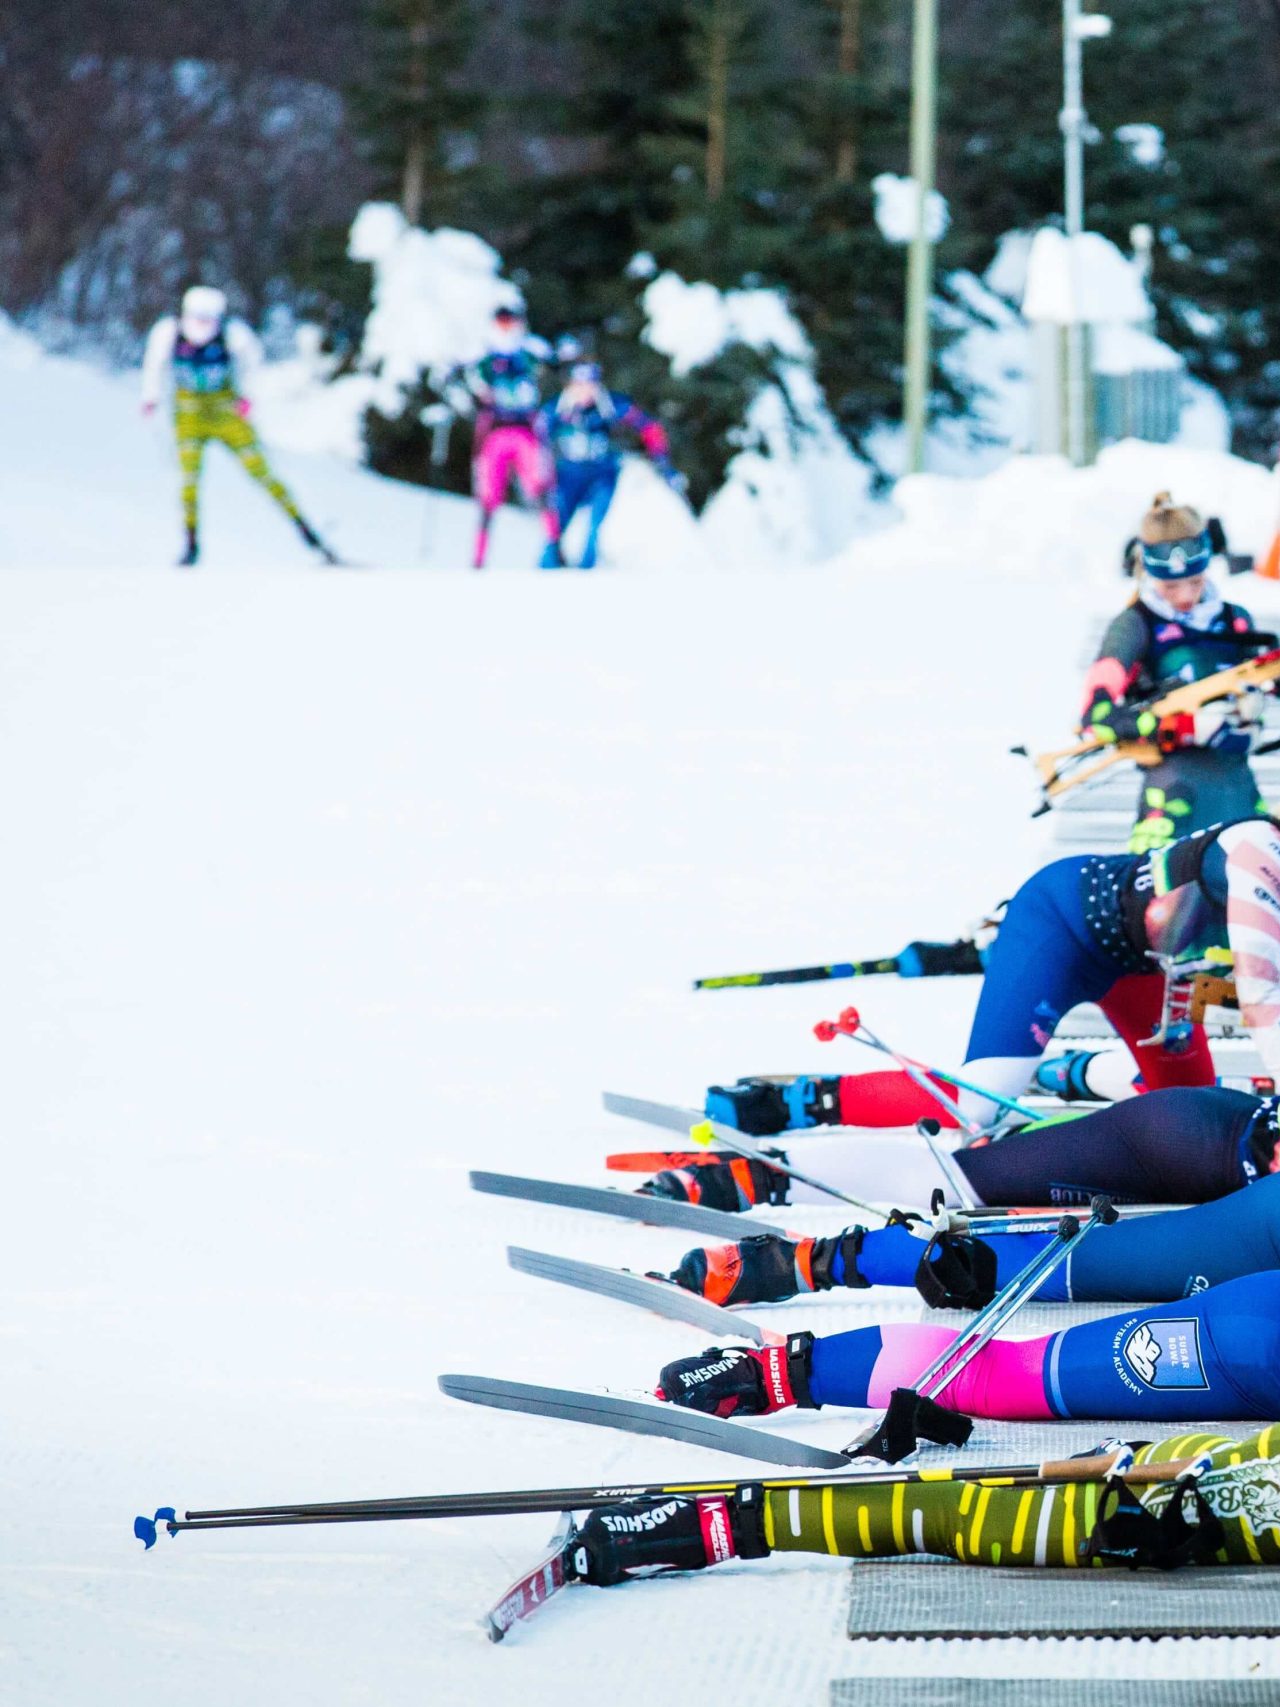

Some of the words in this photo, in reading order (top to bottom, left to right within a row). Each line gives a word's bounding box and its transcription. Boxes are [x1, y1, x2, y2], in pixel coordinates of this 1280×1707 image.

[1112, 1327, 1127, 1349] TEAM
[1124, 1318, 1138, 1328] SKI
[1168, 1337, 1179, 1367] BOWL
[1178, 1335, 1190, 1369] SUGAR
[679, 1357, 741, 1389] MADSHUS
[769, 1348, 786, 1404] MADSHUS
[1113, 1356, 1143, 1396] ACADEMY
